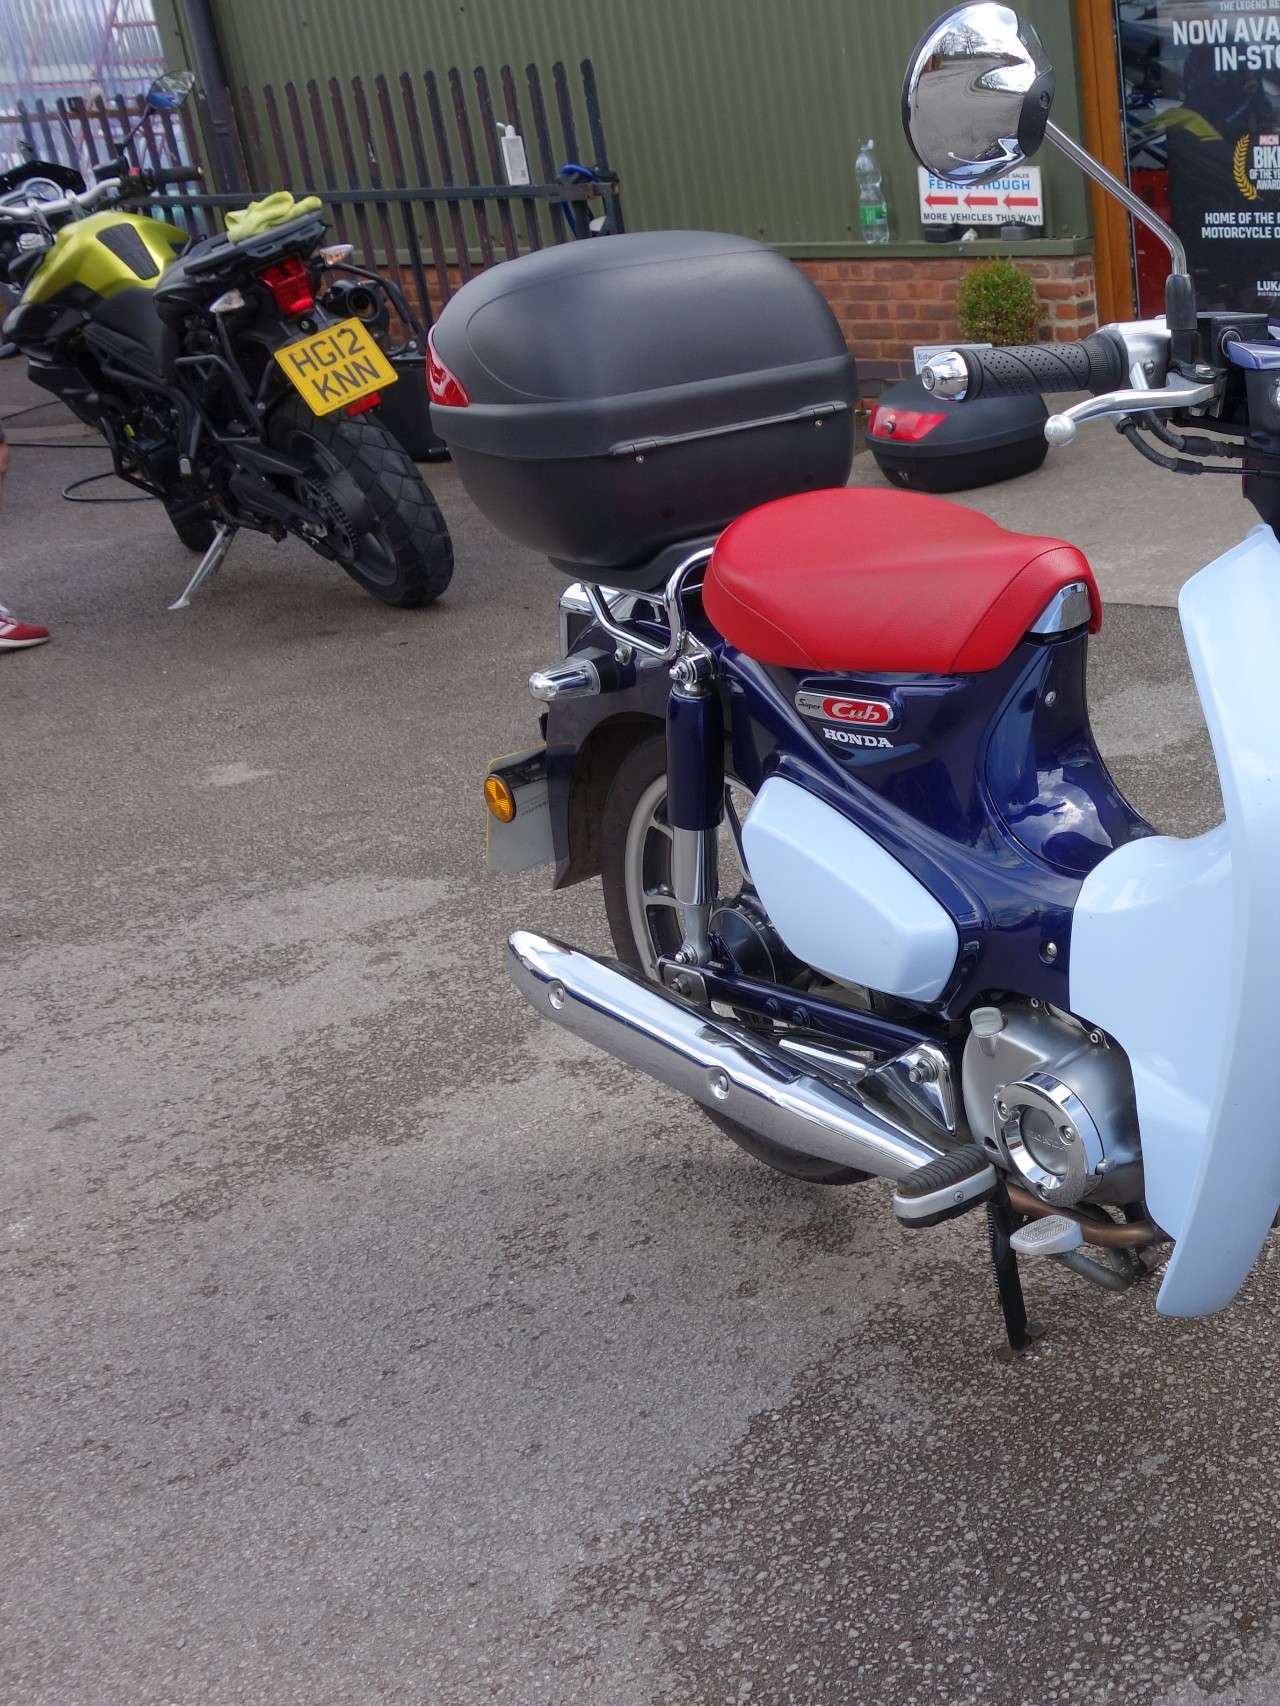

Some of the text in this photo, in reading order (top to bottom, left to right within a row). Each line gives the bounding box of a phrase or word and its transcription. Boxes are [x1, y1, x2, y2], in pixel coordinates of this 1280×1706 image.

[1219, 2, 1234, 11] THE
[1236, 0, 1267, 10] LEGEND
[1172, 18, 1228, 45] NOW
[1259, 135, 1279, 145] MCN
[1249, 169, 1258, 179] OF
[1260, 168, 1273, 179] THE
[923, 213, 947, 221] MORE
[950, 213, 993, 221] VEHICLES
[996, 214, 1016, 222] THIS
[1204, 212, 1236, 224] HOME
[1238, 212, 1252, 224] OF
[1254, 212, 1275, 224] THE
[1201, 226, 1272, 239] MOTORCYCLE
[288, 327, 366, 378] HG12
[312, 355, 381, 403] KNN
[798, 698, 881, 720] Super Cub
[823, 727, 894, 748] HONDA
